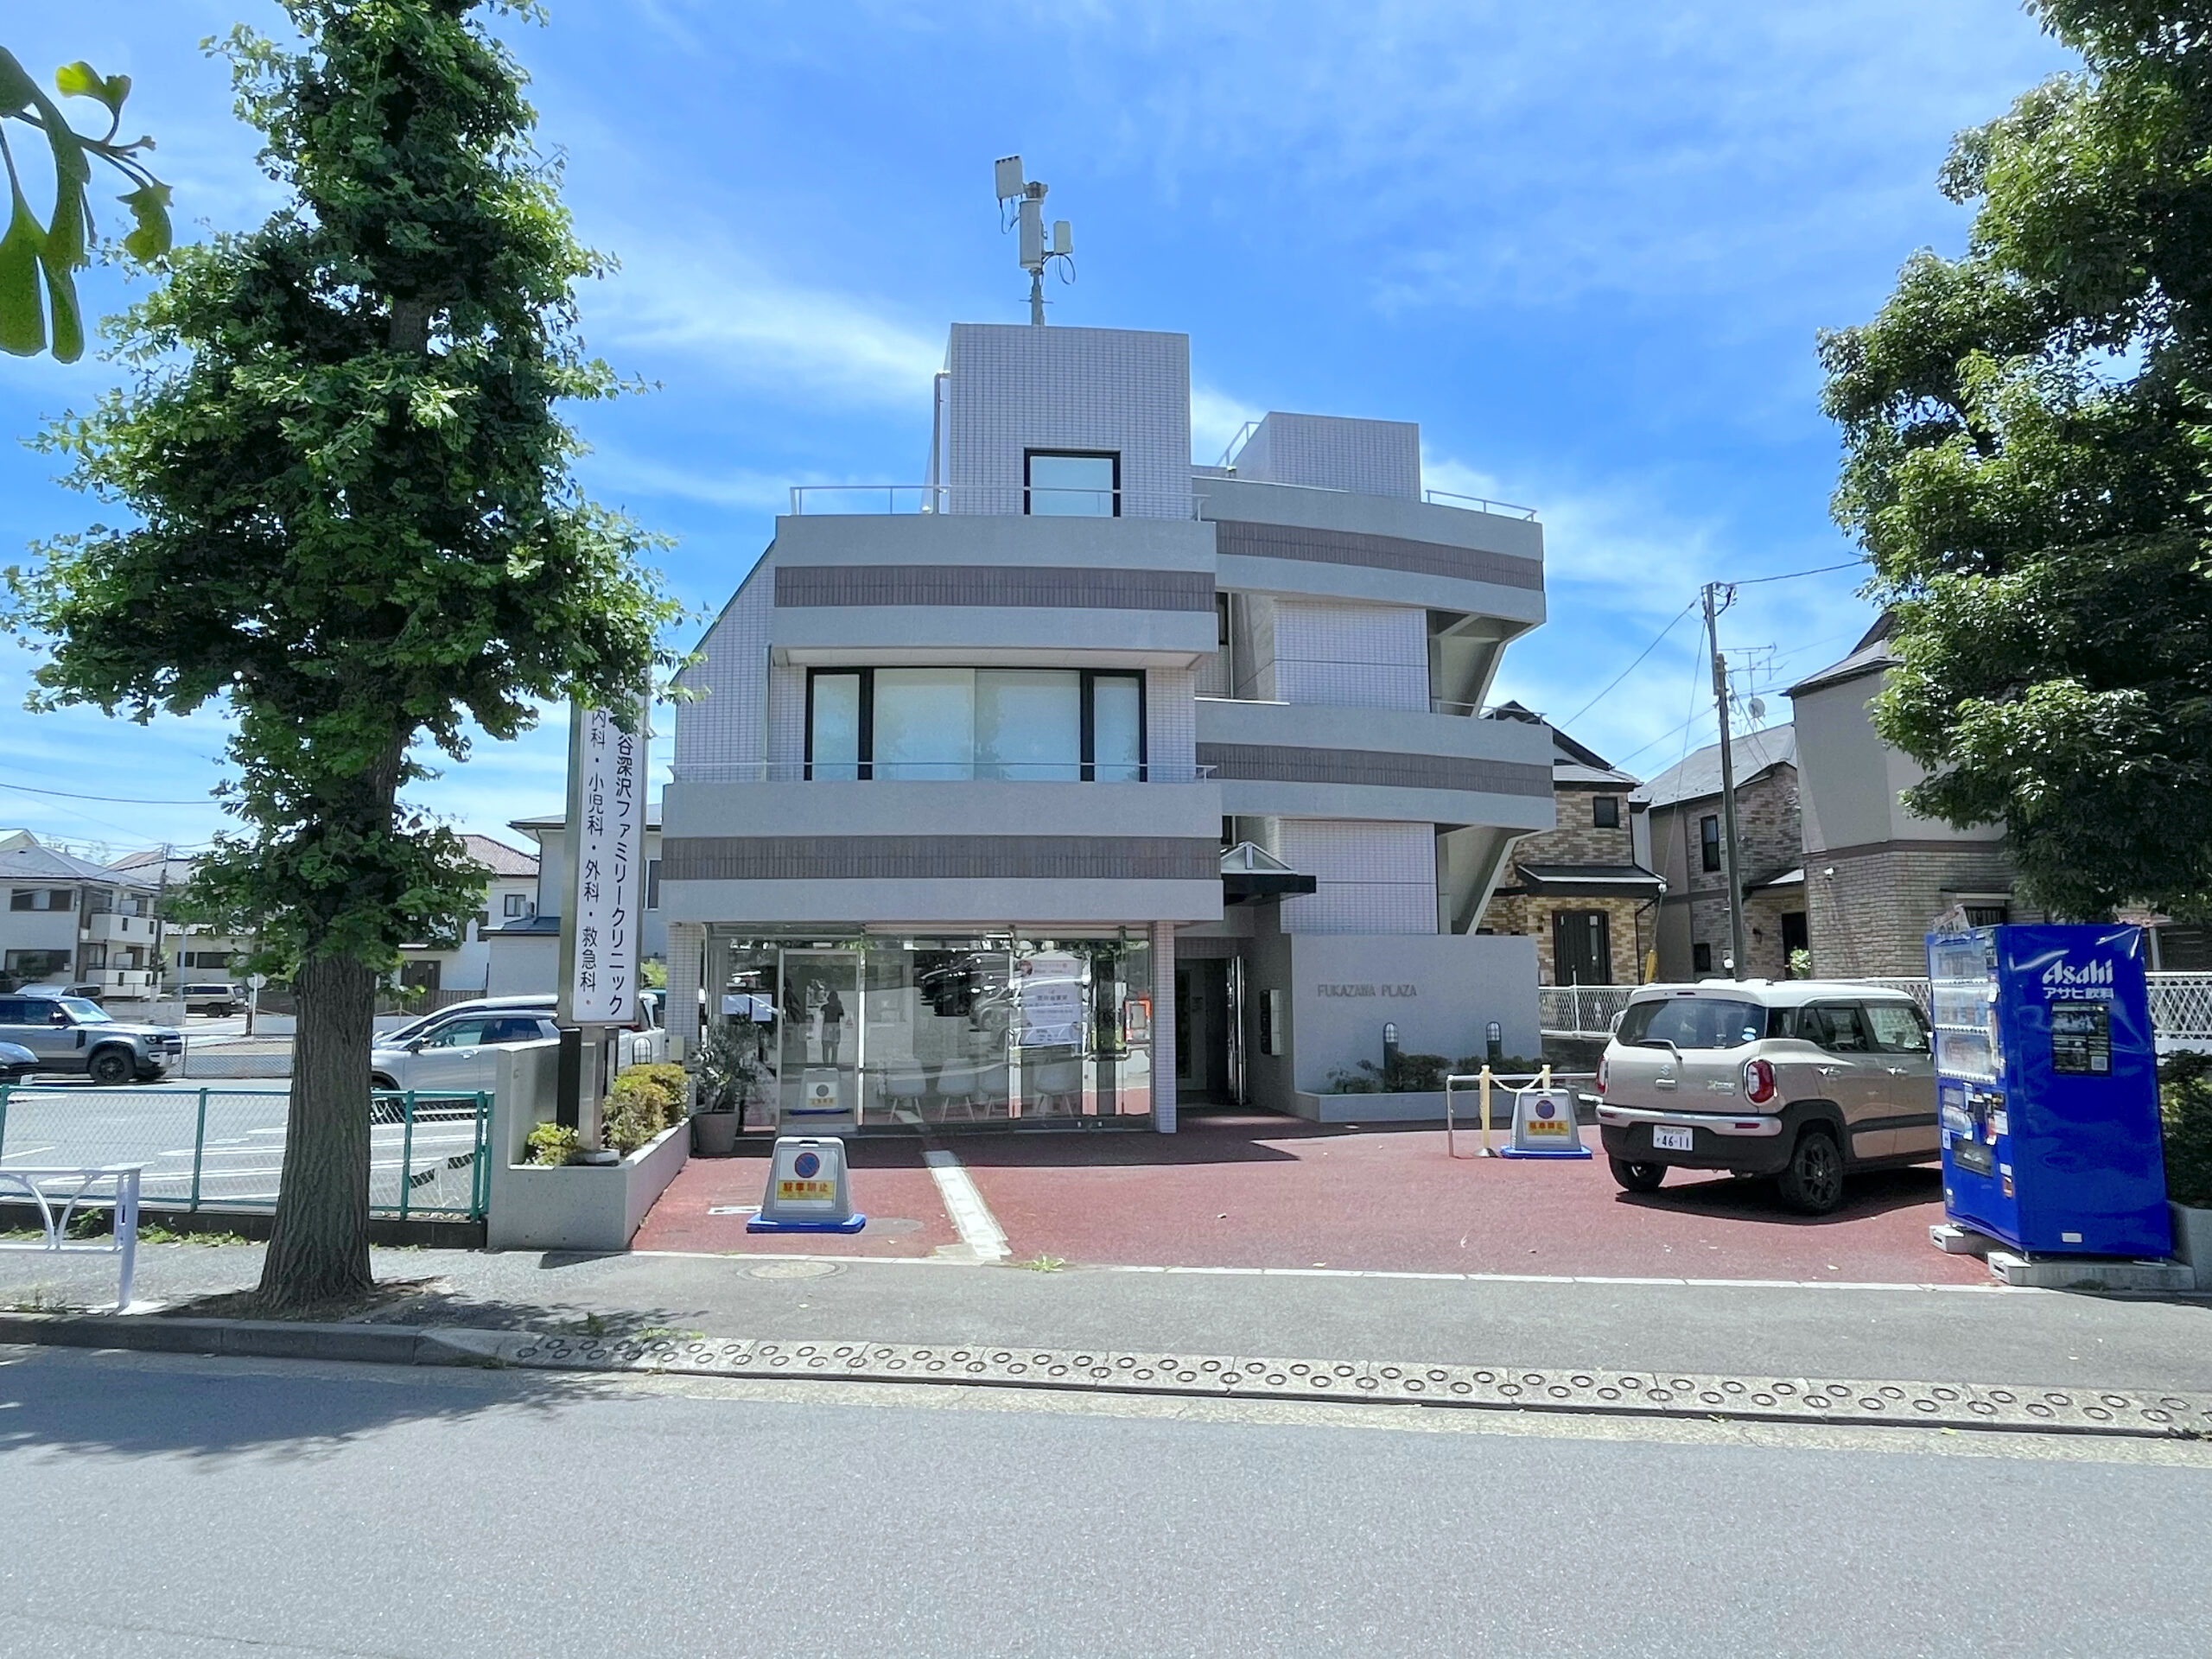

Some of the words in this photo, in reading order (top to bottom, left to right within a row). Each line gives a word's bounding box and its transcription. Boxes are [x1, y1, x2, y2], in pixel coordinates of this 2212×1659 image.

[609, 734, 633, 1015] 谷深沢ファミリークリニック
[2042, 958, 2113, 984] Asahi
[1317, 984, 1376, 997] FUKAZAWA
[1382, 984, 1418, 997] PLAZA
[2043, 987, 2114, 1000] アサヒ飲料
[1662, 1135, 1689, 1149] 46-11
